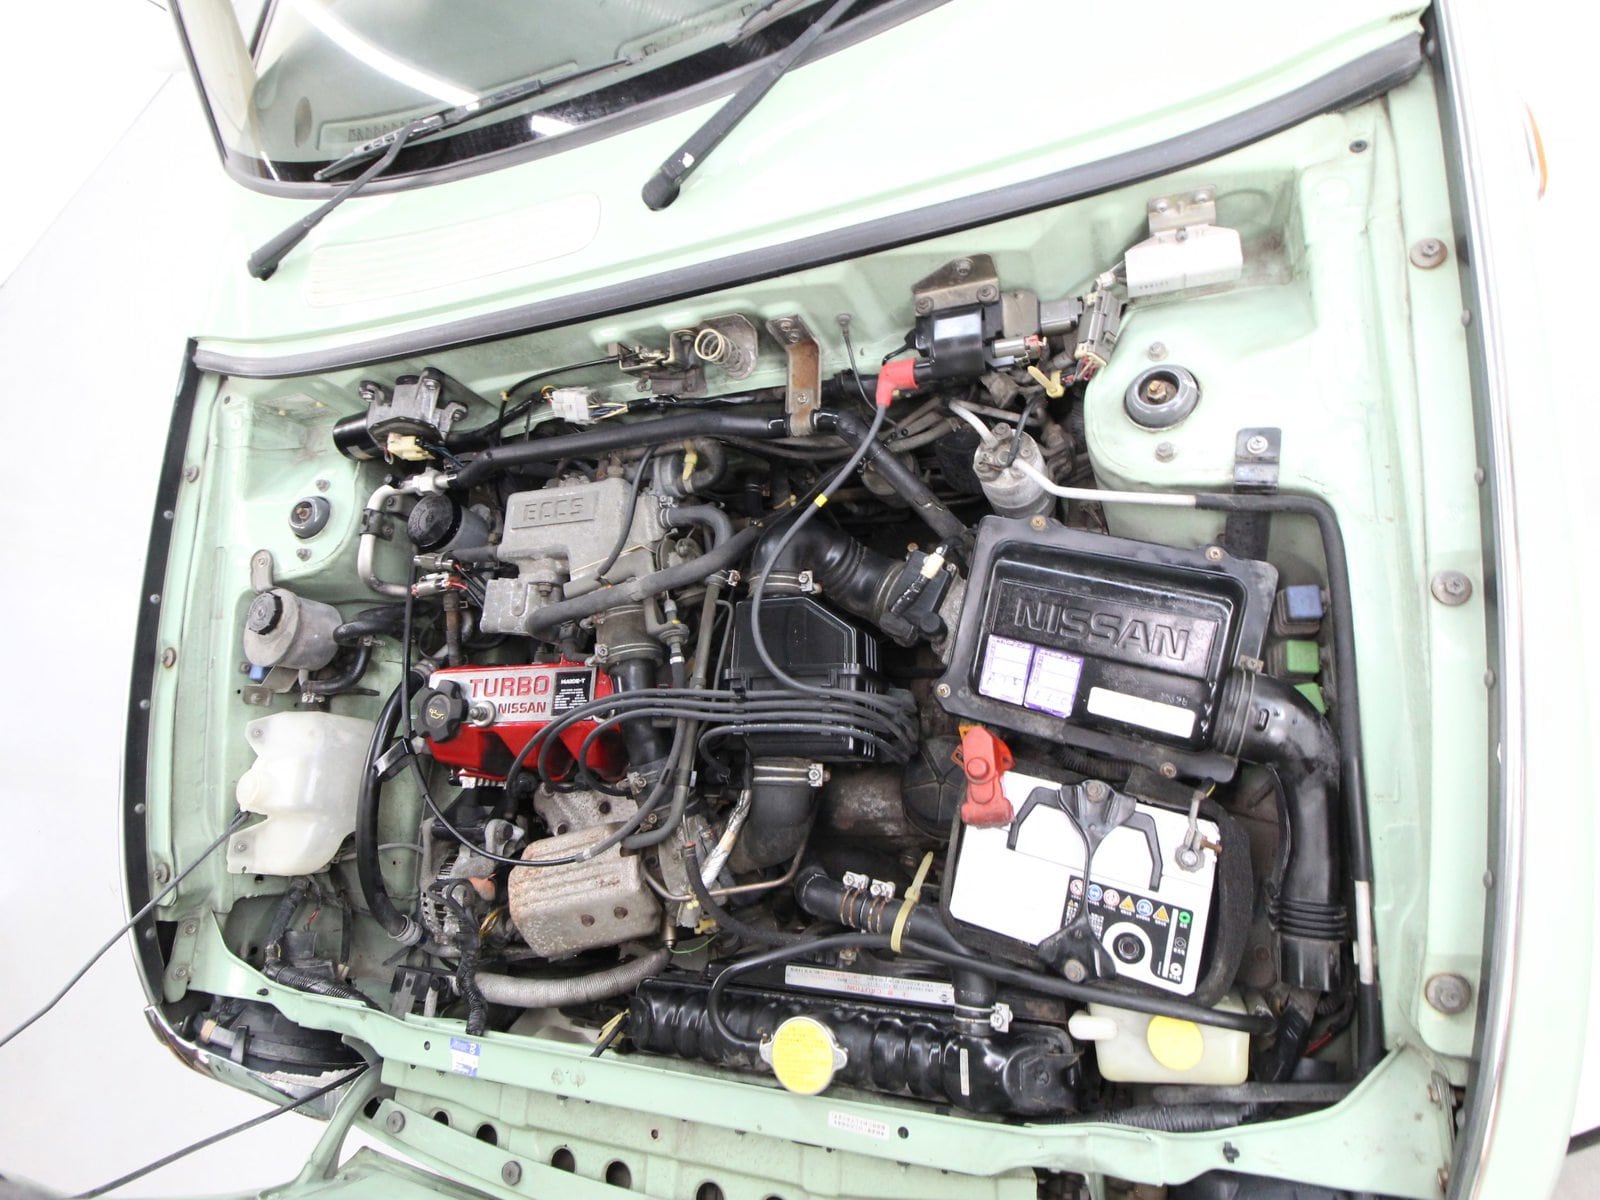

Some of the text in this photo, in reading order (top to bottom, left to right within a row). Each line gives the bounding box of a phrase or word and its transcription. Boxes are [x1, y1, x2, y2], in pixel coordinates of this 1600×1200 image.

[523, 498, 584, 521] ECCS
[1014, 599, 1189, 661] NISSAN
[470, 675, 550, 698] TURBO
[497, 702, 547, 714] NISSAN
